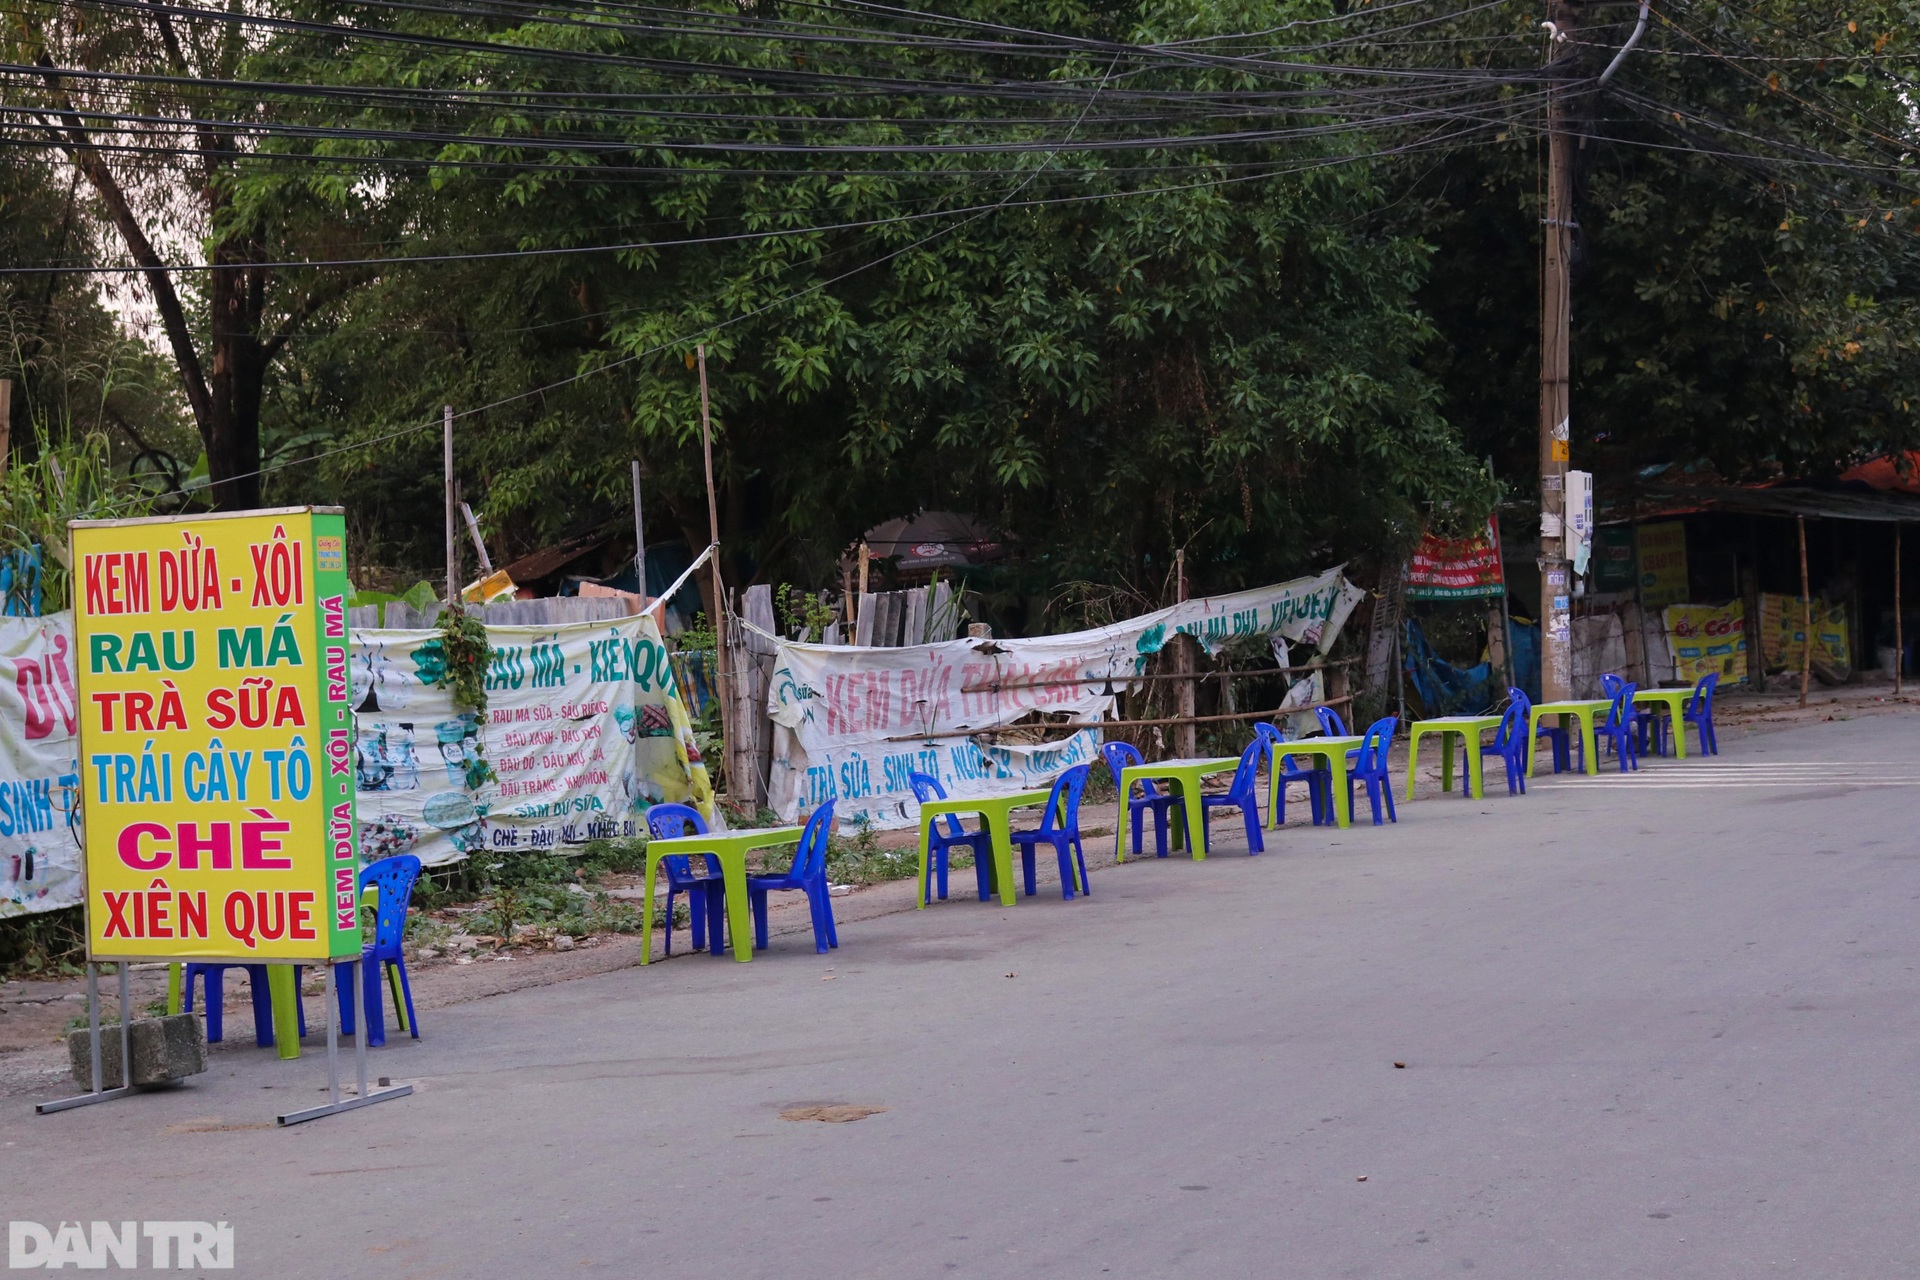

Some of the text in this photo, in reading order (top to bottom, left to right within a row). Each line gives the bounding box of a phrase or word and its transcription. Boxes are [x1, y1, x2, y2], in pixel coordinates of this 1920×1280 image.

[84, 552, 150, 616] KEM
[159, 531, 223, 612] DỪA
[250, 524, 304, 608] XÔI
[90, 613, 303, 674] RAU MÁ
[319, 594, 344, 638] MÁ
[326, 646, 347, 702] RAU
[530, 633, 566, 688] MÁ
[92, 677, 307, 733] TRÀ SỮA
[493, 709, 512, 724] RAU
[515, 705, 530, 721] MÁ
[533, 703, 552, 721] SỮA
[826, 670, 891, 736] KEM
[900, 651, 952, 728] DỪA
[325, 729, 350, 777] XÔI
[500, 754, 520, 774] ĐẬU
[543, 751, 564, 771] ĐẬU
[505, 730, 527, 749] ĐẬU
[528, 731, 554, 745] XANH
[561, 727, 580, 745] ĐẬU
[91, 735, 312, 804] TRÁI CÂY TÔ
[500, 779, 520, 798] ĐẬU
[807, 754, 838, 804] TRÀ
[841, 751, 872, 800] SỮA
[883, 752, 916, 793] SINH
[0, 779, 53, 838] SINH
[329, 802, 354, 860] DỪA
[515, 802, 549, 818] SÂM
[575, 794, 604, 812] SỮA
[117, 808, 293, 871] CHÈ
[493, 825, 518, 847] CHÈ
[531, 825, 555, 849] ĐẬU
[102, 878, 317, 949] XIÊN QUE
[335, 869, 356, 931] KEM
